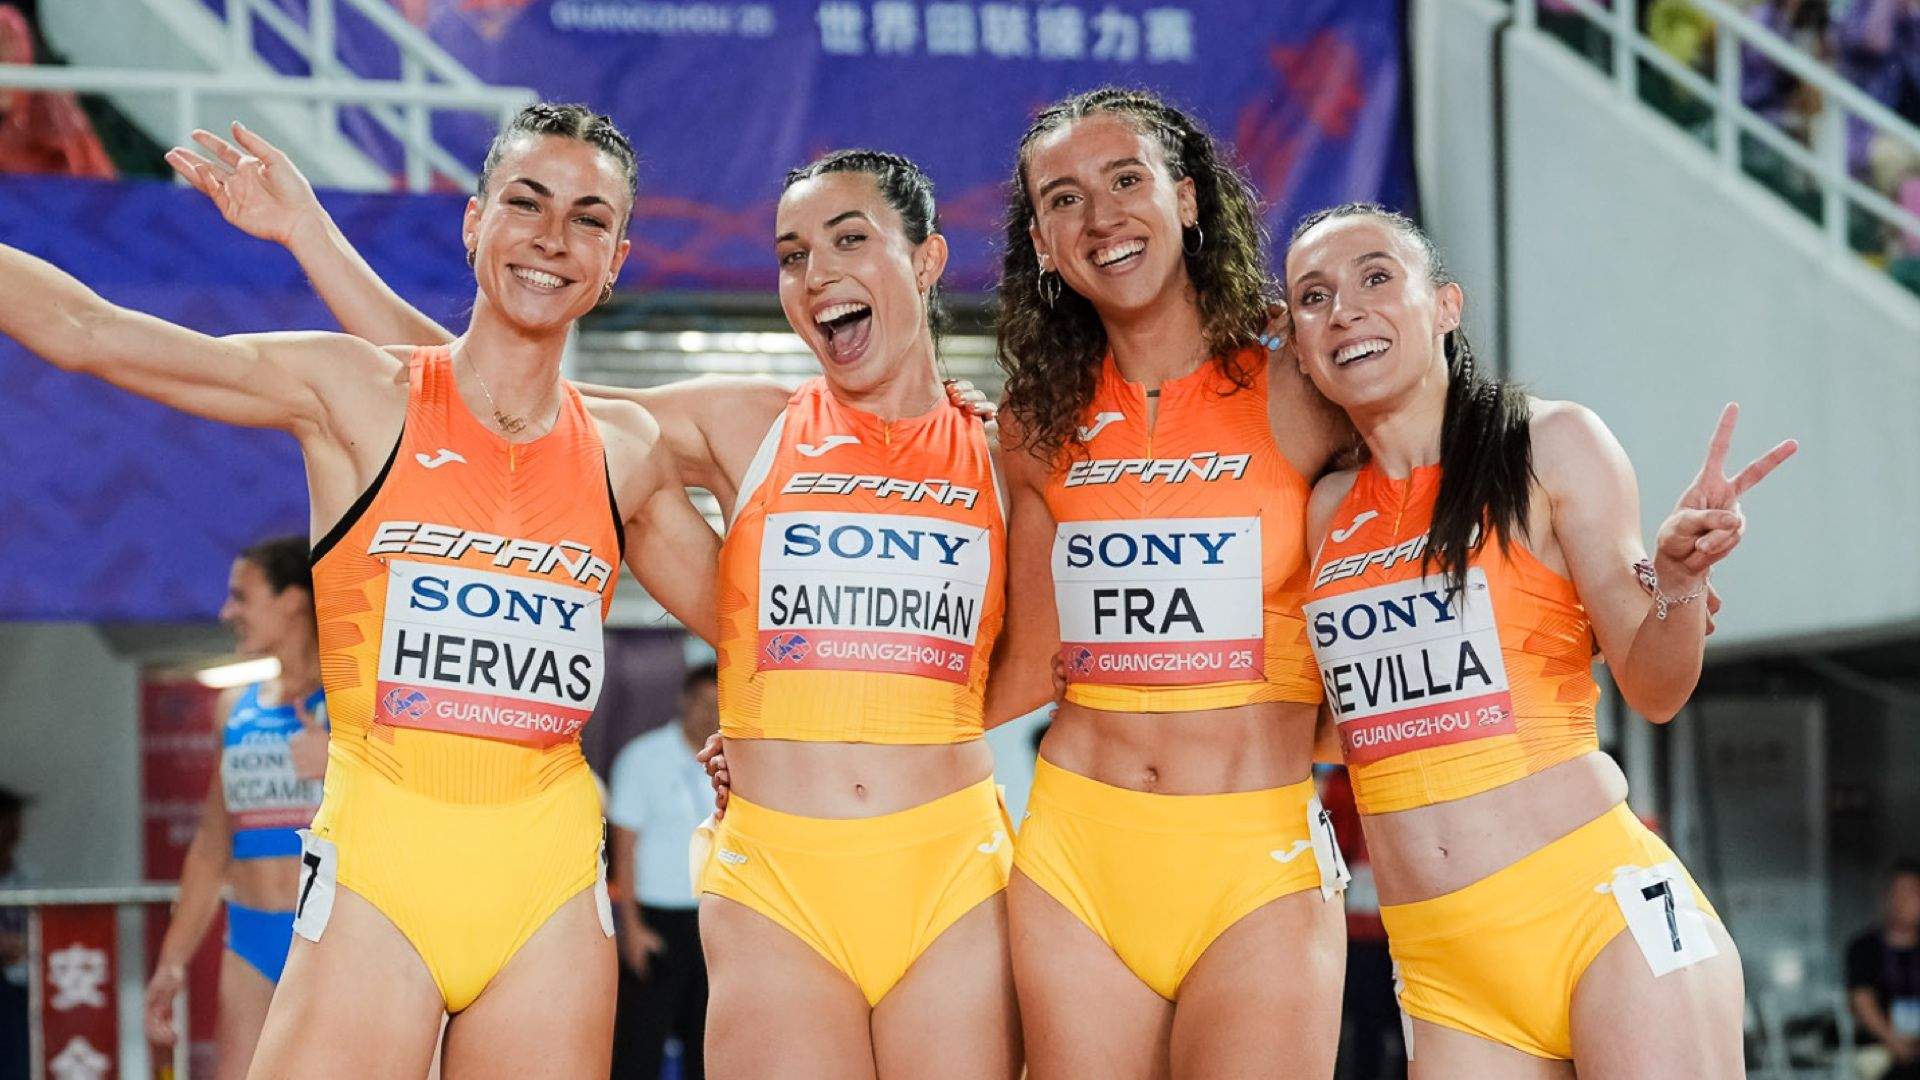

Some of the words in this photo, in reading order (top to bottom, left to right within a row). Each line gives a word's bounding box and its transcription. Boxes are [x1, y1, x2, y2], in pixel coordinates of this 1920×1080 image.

[781, 473, 978, 510] ESPAÑA
[1064, 452, 1251, 487] ESPAÑA
[367, 521, 613, 594] ESPAÑA
[784, 523, 969, 565] SONY
[1067, 532, 1236, 568] SONY
[409, 575, 583, 631] SONY
[770, 582, 974, 638] SANTIDRIÁN
[1093, 587, 1204, 635] FRA
[1314, 588, 1463, 648] SONY
[394, 629, 592, 702] HERVAS
[816, 640, 945, 666] GUANGZHOU
[947, 653, 965, 672] 25
[1099, 652, 1222, 672] GUANGZHOU
[1229, 650, 1253, 669] 25
[1324, 640, 1492, 716] SEVILLA
[436, 701, 564, 734] GUANGZHOU
[1352, 710, 1470, 749] GUANGZHOU
[1476, 705, 1503, 726] 25
[297, 850, 321, 919] 7
[1640, 880, 1683, 953] 7
